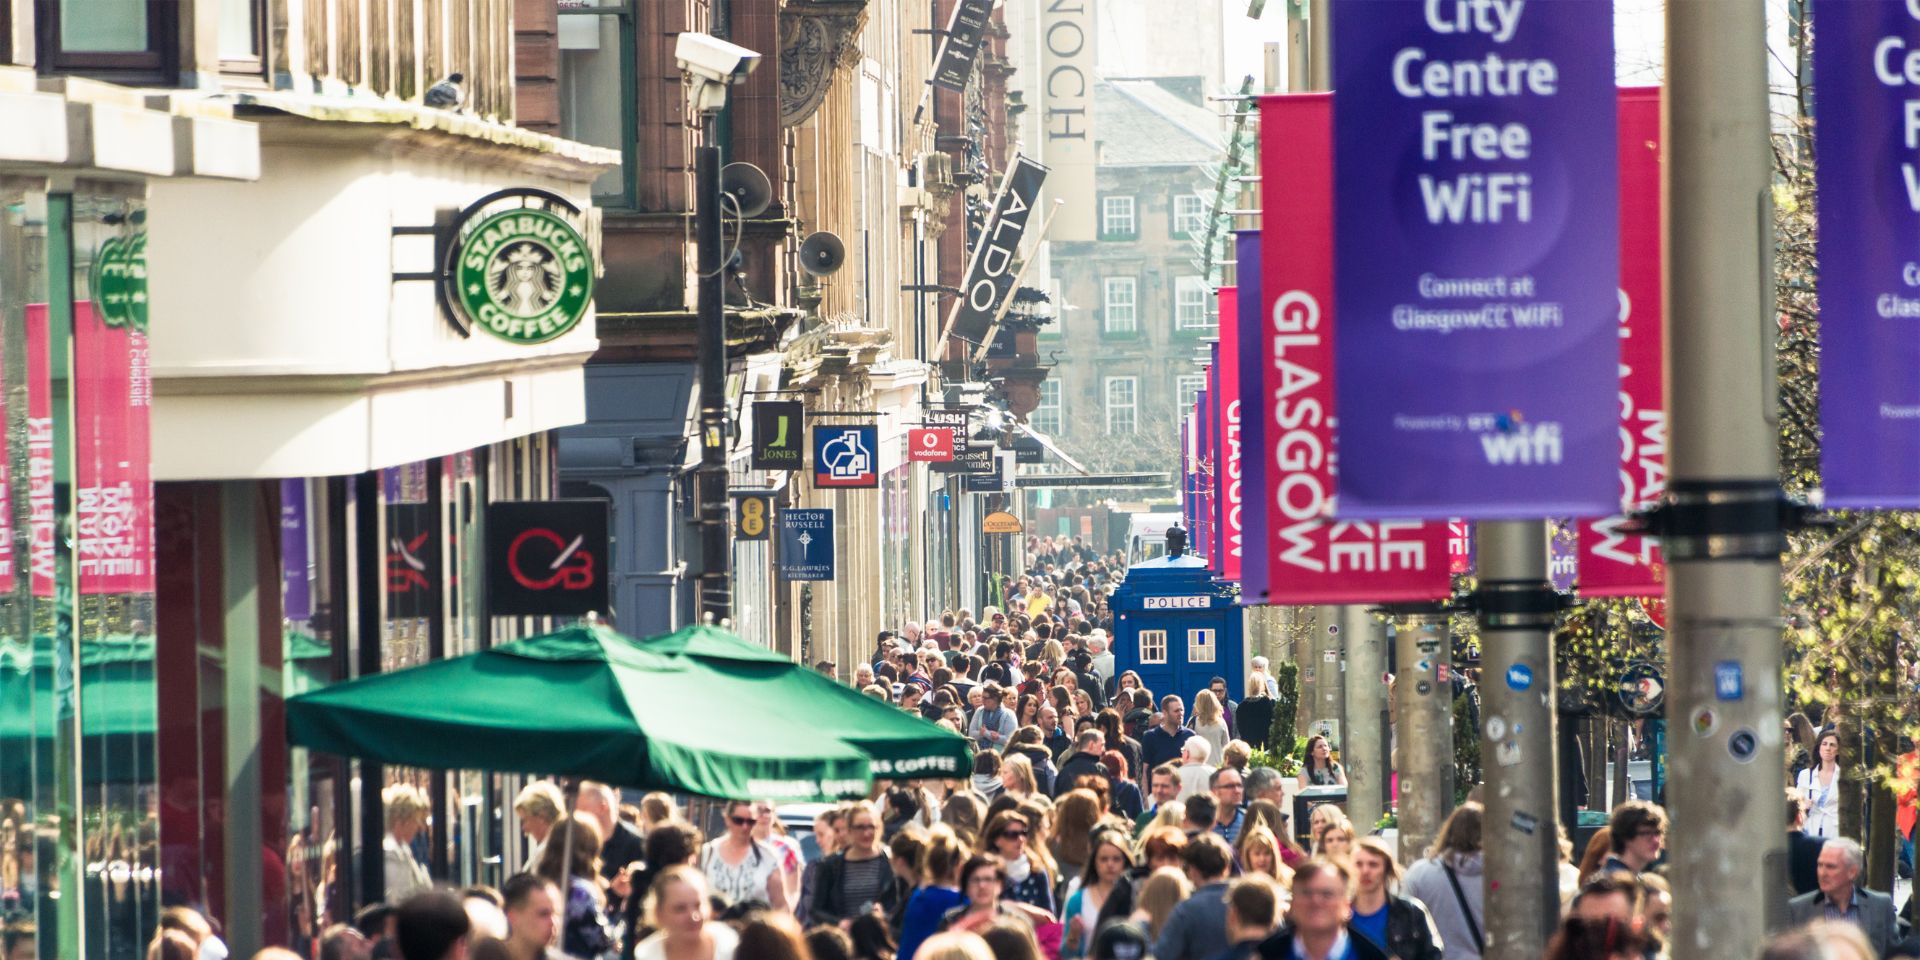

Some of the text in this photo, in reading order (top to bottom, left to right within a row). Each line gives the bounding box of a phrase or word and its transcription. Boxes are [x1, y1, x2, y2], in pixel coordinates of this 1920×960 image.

[1425, 0, 1524, 42] City
[1393, 48, 1558, 97] Centre
[1421, 111, 1531, 160] Free
[1419, 174, 1532, 224] WiFi
[465, 216, 586, 273] STARBUCKS
[971, 188, 1028, 312] ALDO
[1419, 273, 1534, 297] Connect at
[479, 303, 570, 338] COFFEE
[1512, 305, 1562, 328] WiFi
[925, 413, 966, 425] LUSH
[1880, 404, 1920, 418] Powere
[1273, 290, 1326, 573] GLASGOW
[1481, 422, 1562, 465] wifi
[759, 448, 798, 460] JONES
[965, 451, 988, 460] ussell
[785, 512, 825, 521] HECTOR
[785, 521, 825, 529] RUSSELL
[1148, 598, 1206, 608] POLICE
[895, 757, 957, 773] COFFEE
